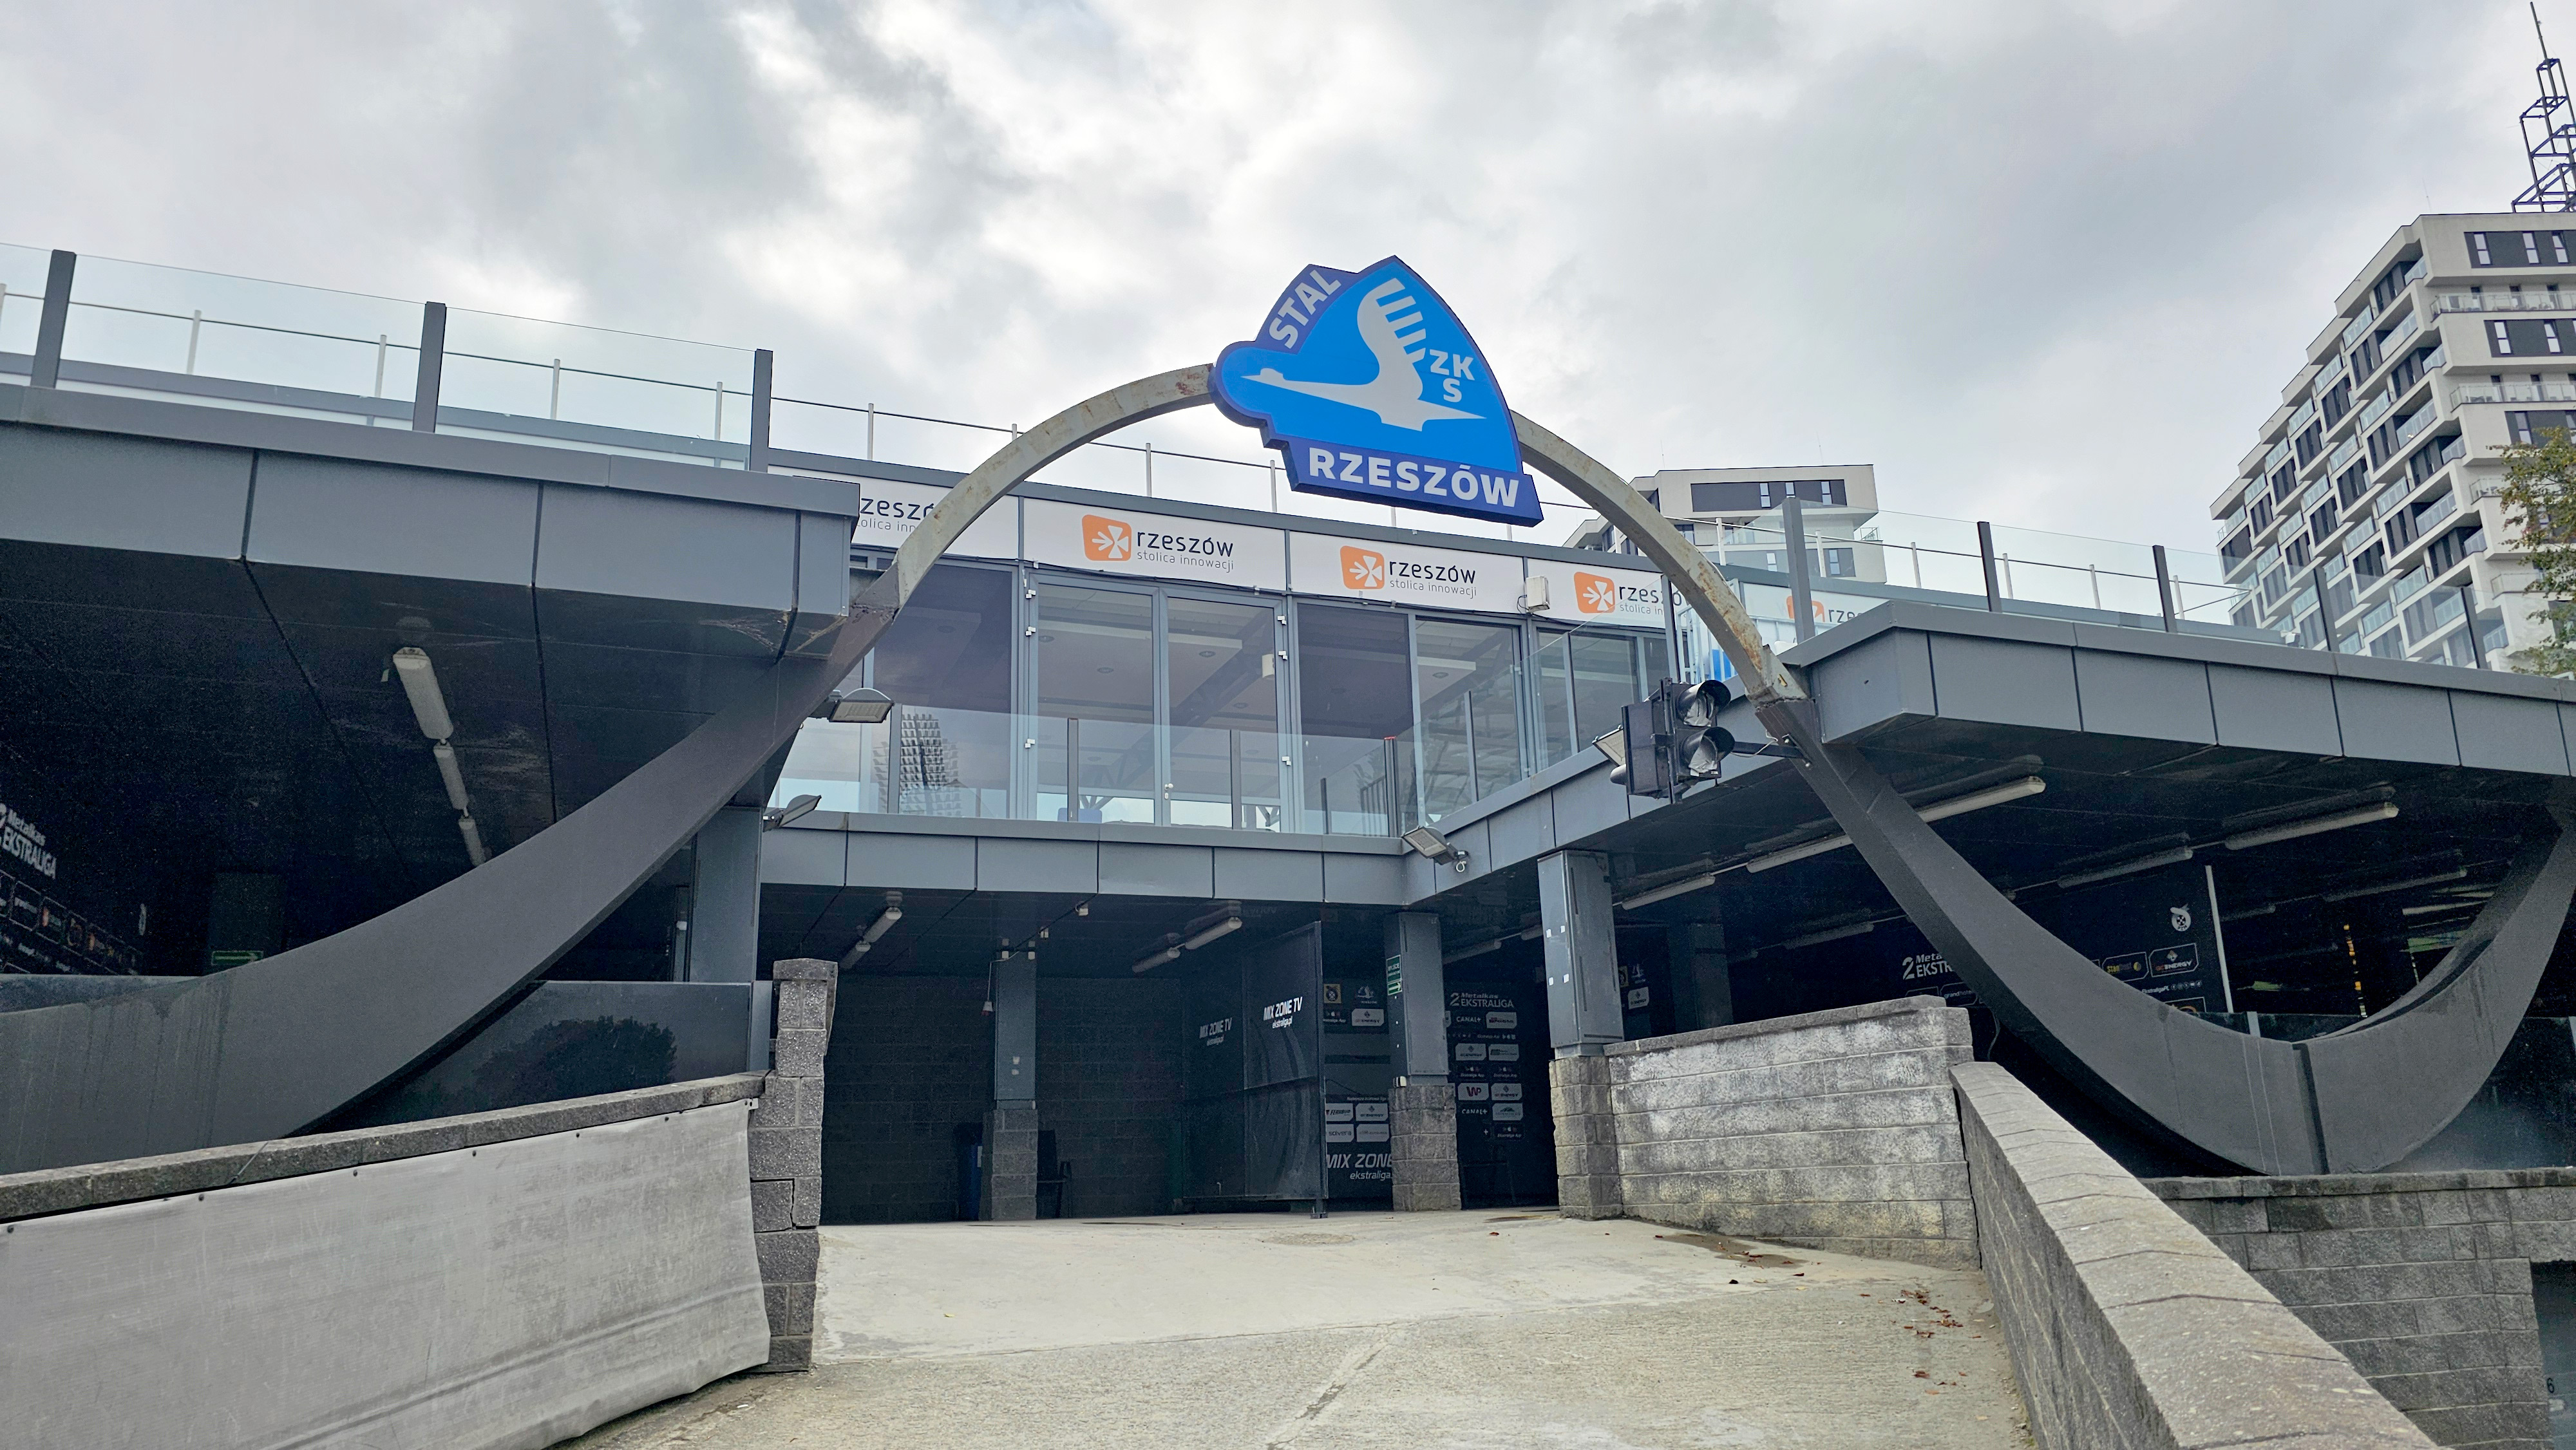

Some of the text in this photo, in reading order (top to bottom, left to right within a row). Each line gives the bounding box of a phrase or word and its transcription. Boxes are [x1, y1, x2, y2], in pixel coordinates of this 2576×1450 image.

[1269, 269, 1341, 349] STAL
[1309, 446, 1519, 508] RZESZÓW
[860, 498, 934, 521] zesz
[857, 518, 891, 531] olica
[1137, 532, 1233, 558] rzeszów
[1137, 550, 1234, 573] stolica innowacji
[1389, 561, 1475, 584] rzeszów
[1390, 578, 1477, 599] stolica innowacji
[1620, 603, 1651, 614] stolica
[1916, 953, 1943, 964] Meta
[1916, 961, 1953, 977] EKSTR
[1264, 996, 1303, 1021] MIX ZONE TV
[1461, 999, 1515, 1008] EKSTRALIGA
[1326, 1153, 1352, 1169] MIX
[1350, 1171, 1392, 1181] ekstraliga.
